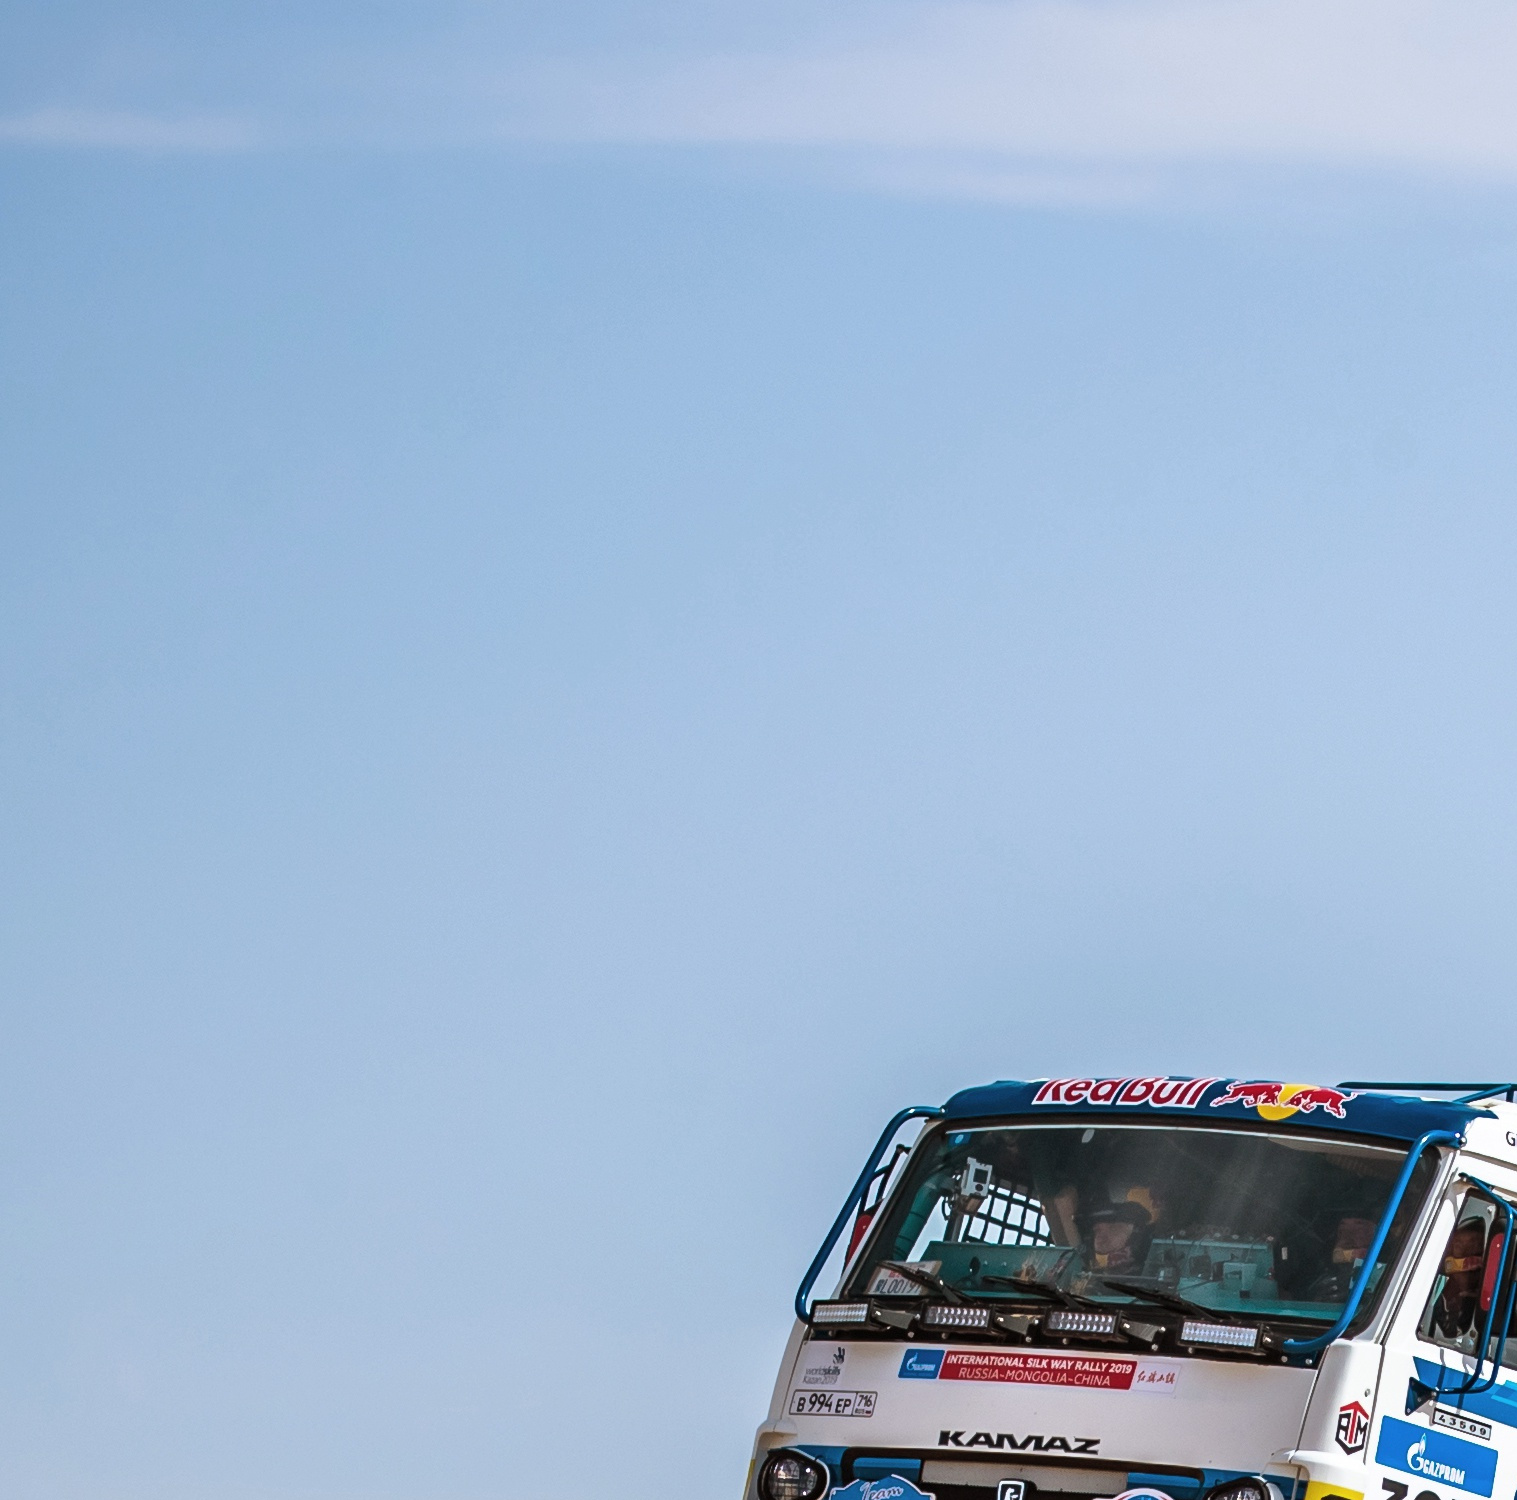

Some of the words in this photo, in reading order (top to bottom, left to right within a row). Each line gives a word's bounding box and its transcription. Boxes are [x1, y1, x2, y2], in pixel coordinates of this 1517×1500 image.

[947, 1354, 1025, 1369] INTERNATIONAL
[1026, 1358, 1050, 1369] SILK
[1050, 1359, 1075, 1371] WAY
[1075, 1361, 1108, 1373] RALLY
[1109, 1362, 1133, 1375] 2019
[808, 1393, 834, 1412] 994
[938, 1430, 1101, 1455] KAMAZ
